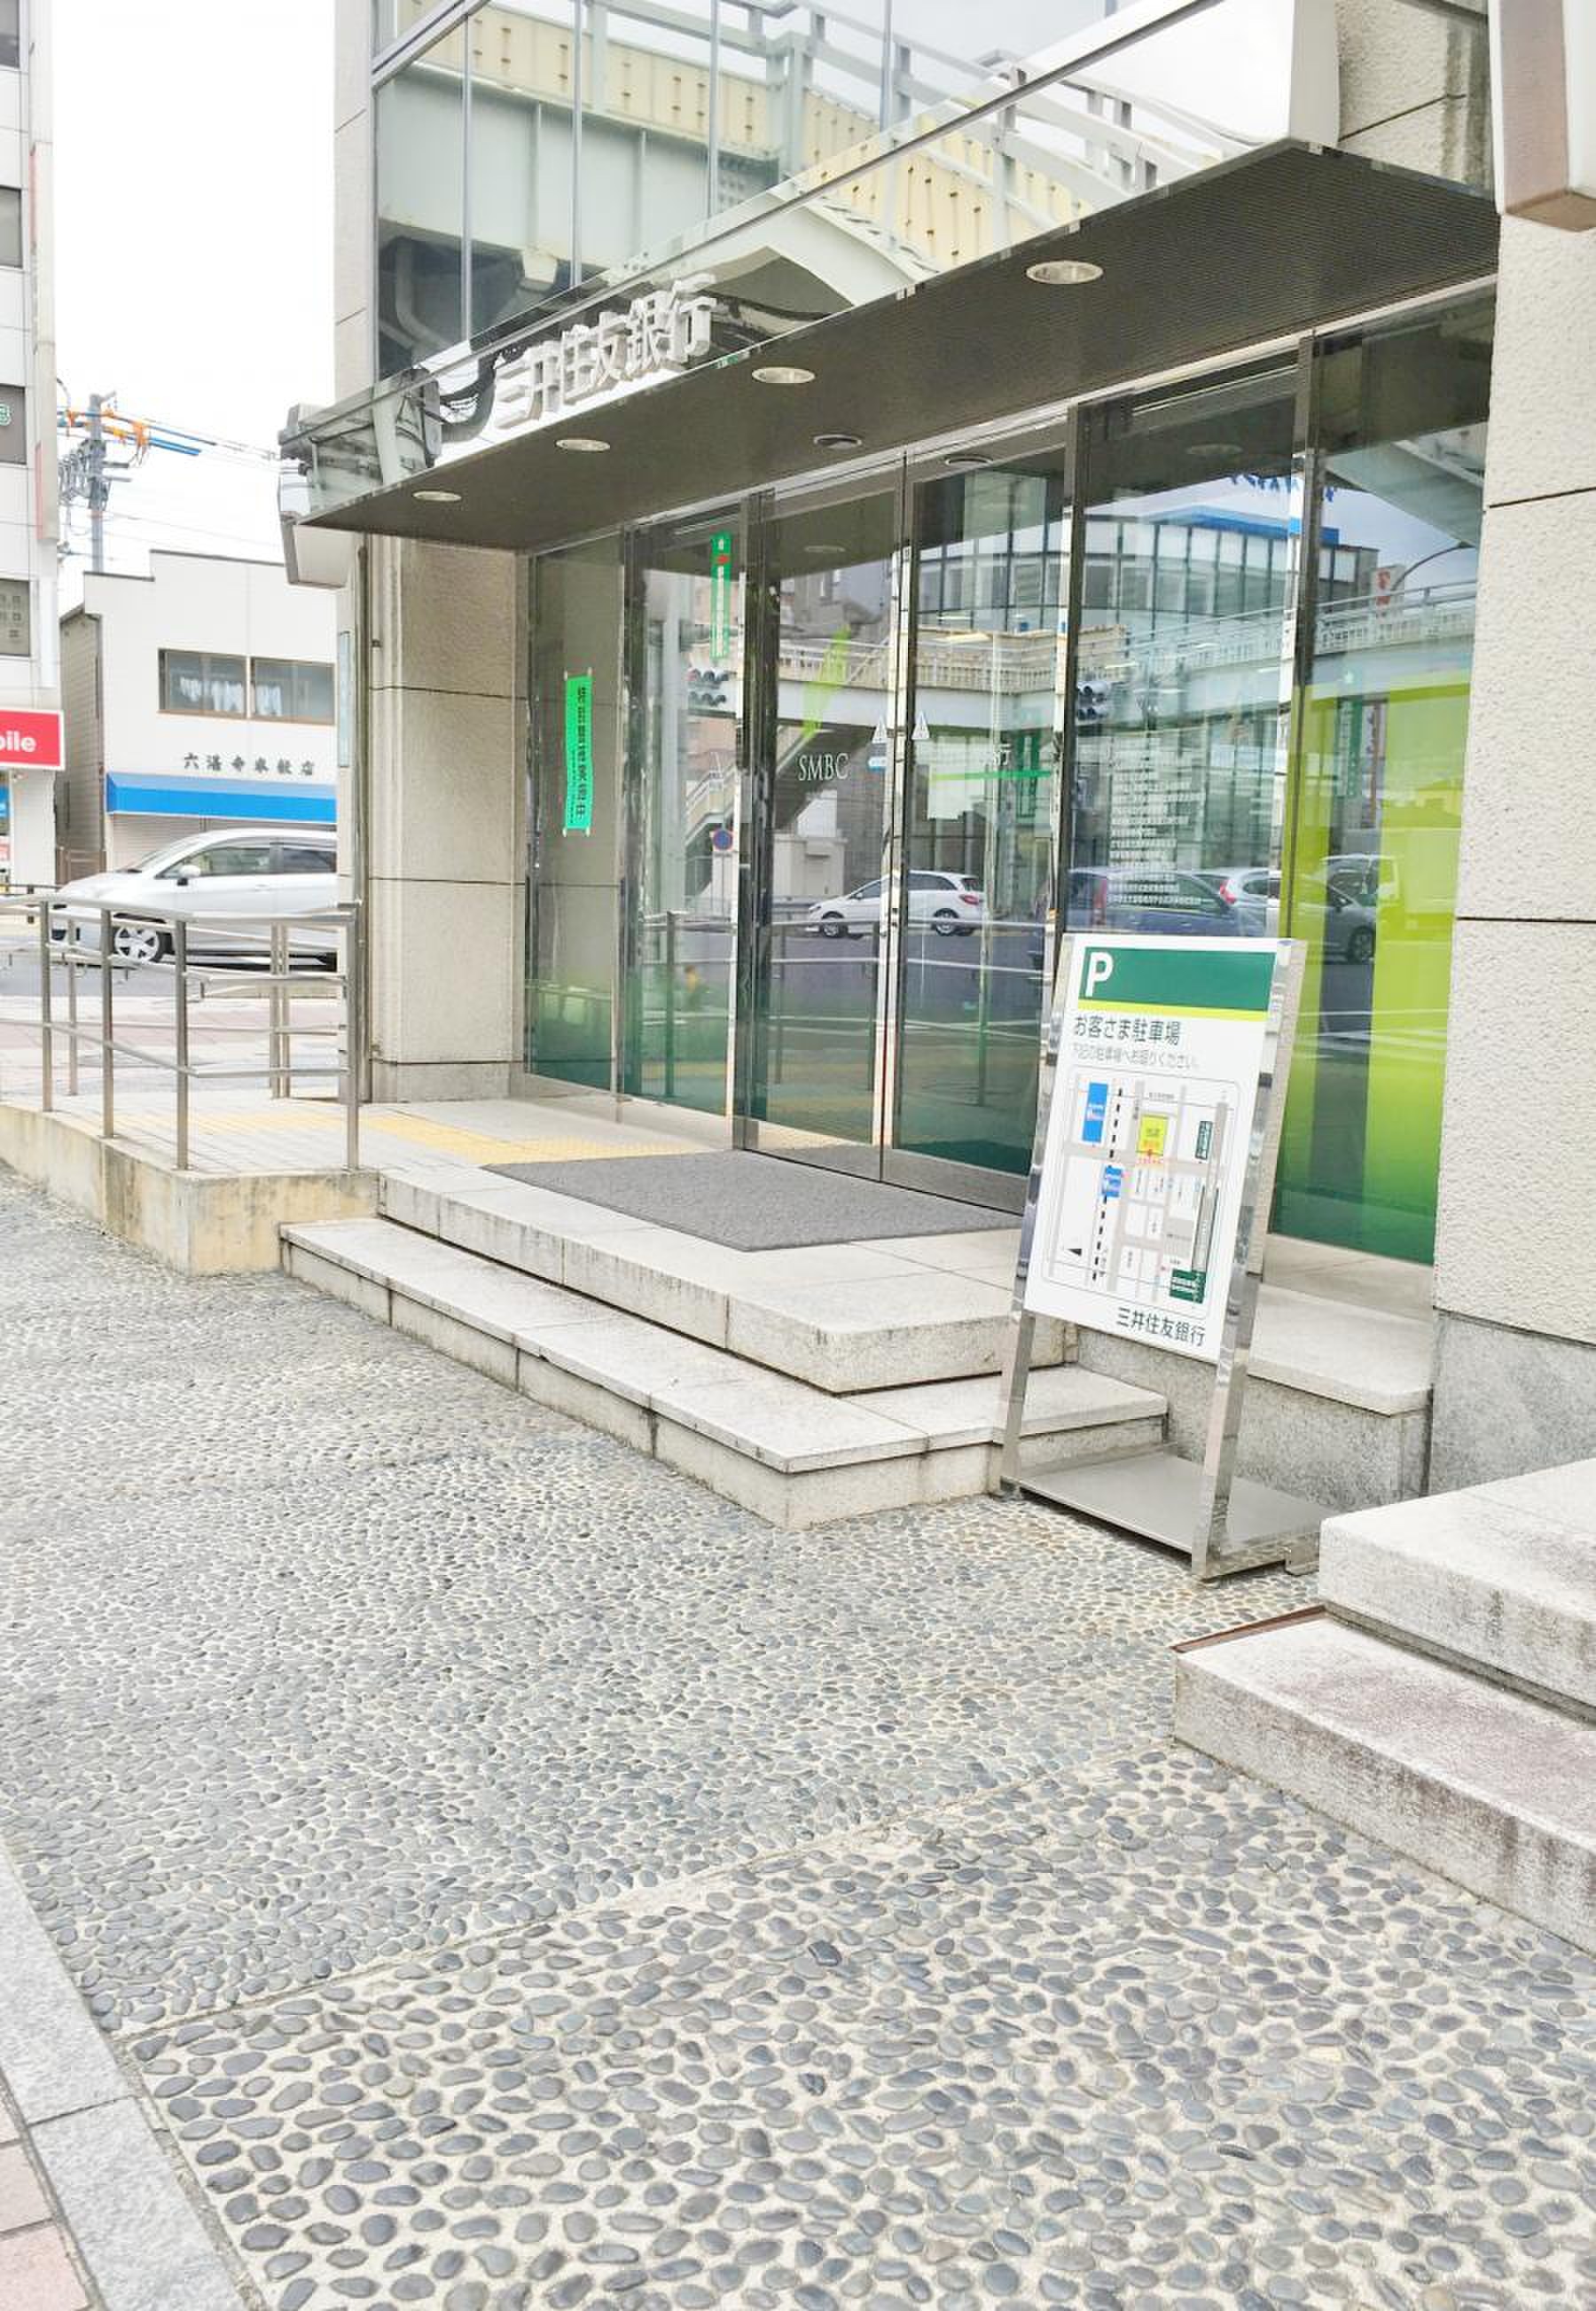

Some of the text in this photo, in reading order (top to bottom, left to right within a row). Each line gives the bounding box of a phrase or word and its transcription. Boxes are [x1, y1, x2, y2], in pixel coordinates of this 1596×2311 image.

[492, 272, 716, 430] 三井住友銀行
[797, 752, 849, 781] SMBC
[1084, 952, 1113, 998] P
[1074, 1014, 1181, 1046] お客さま駐車場
[1115, 1306, 1207, 1347] 三井住友銀行
